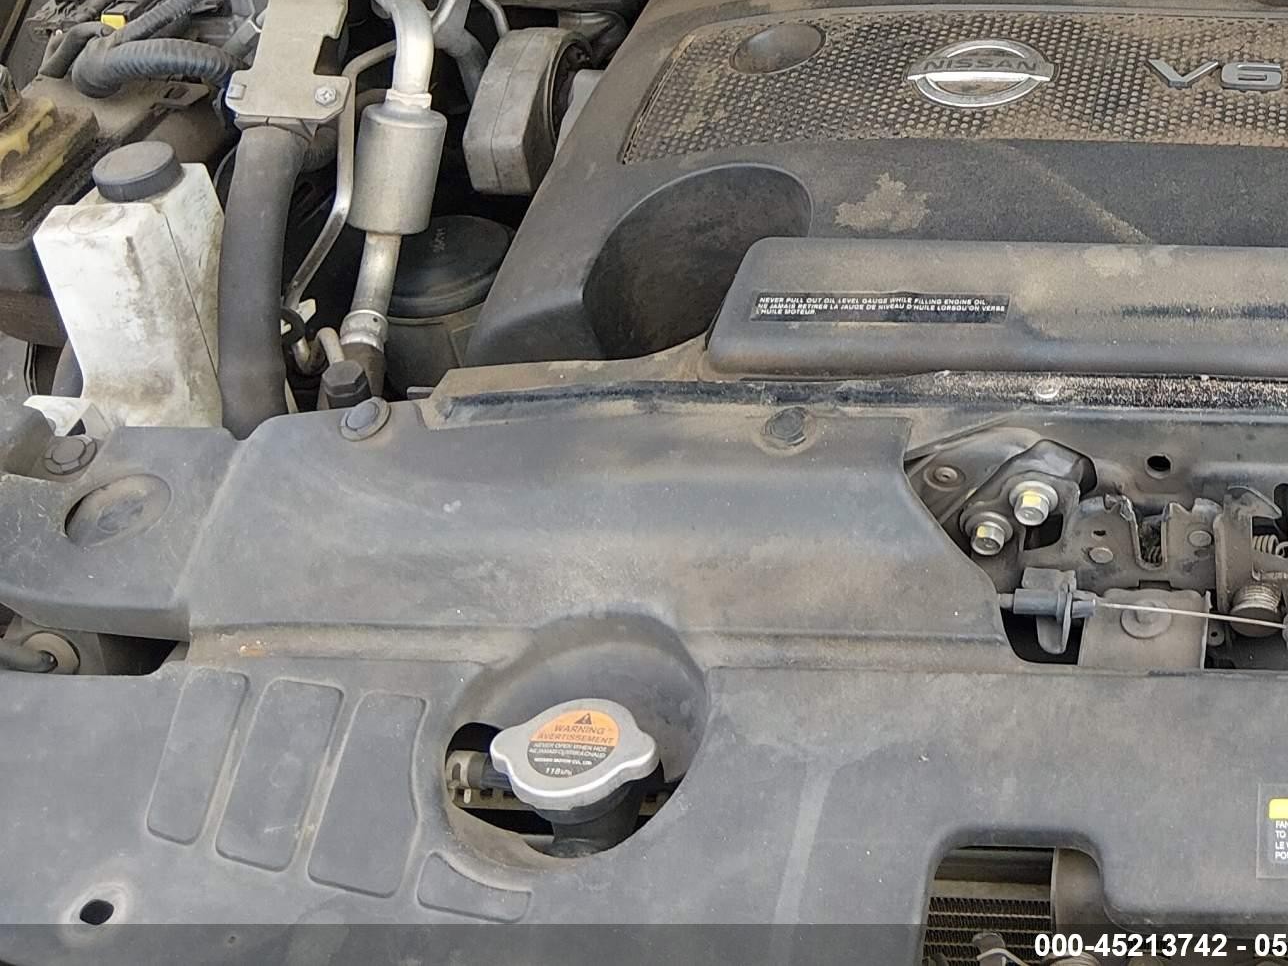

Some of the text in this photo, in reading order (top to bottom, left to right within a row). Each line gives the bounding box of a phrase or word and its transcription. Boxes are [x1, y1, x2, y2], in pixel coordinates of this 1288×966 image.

[922, 58, 1038, 72] NISSAN
[1146, 58, 1283, 90] V6
[906, 304, 935, 312] D'HUILE
[554, 724, 606, 735] WARNING
[535, 732, 614, 745] AVERTISSEMENT
[1275, 830, 1286, 839] TO
[1275, 842, 1286, 850] LE
